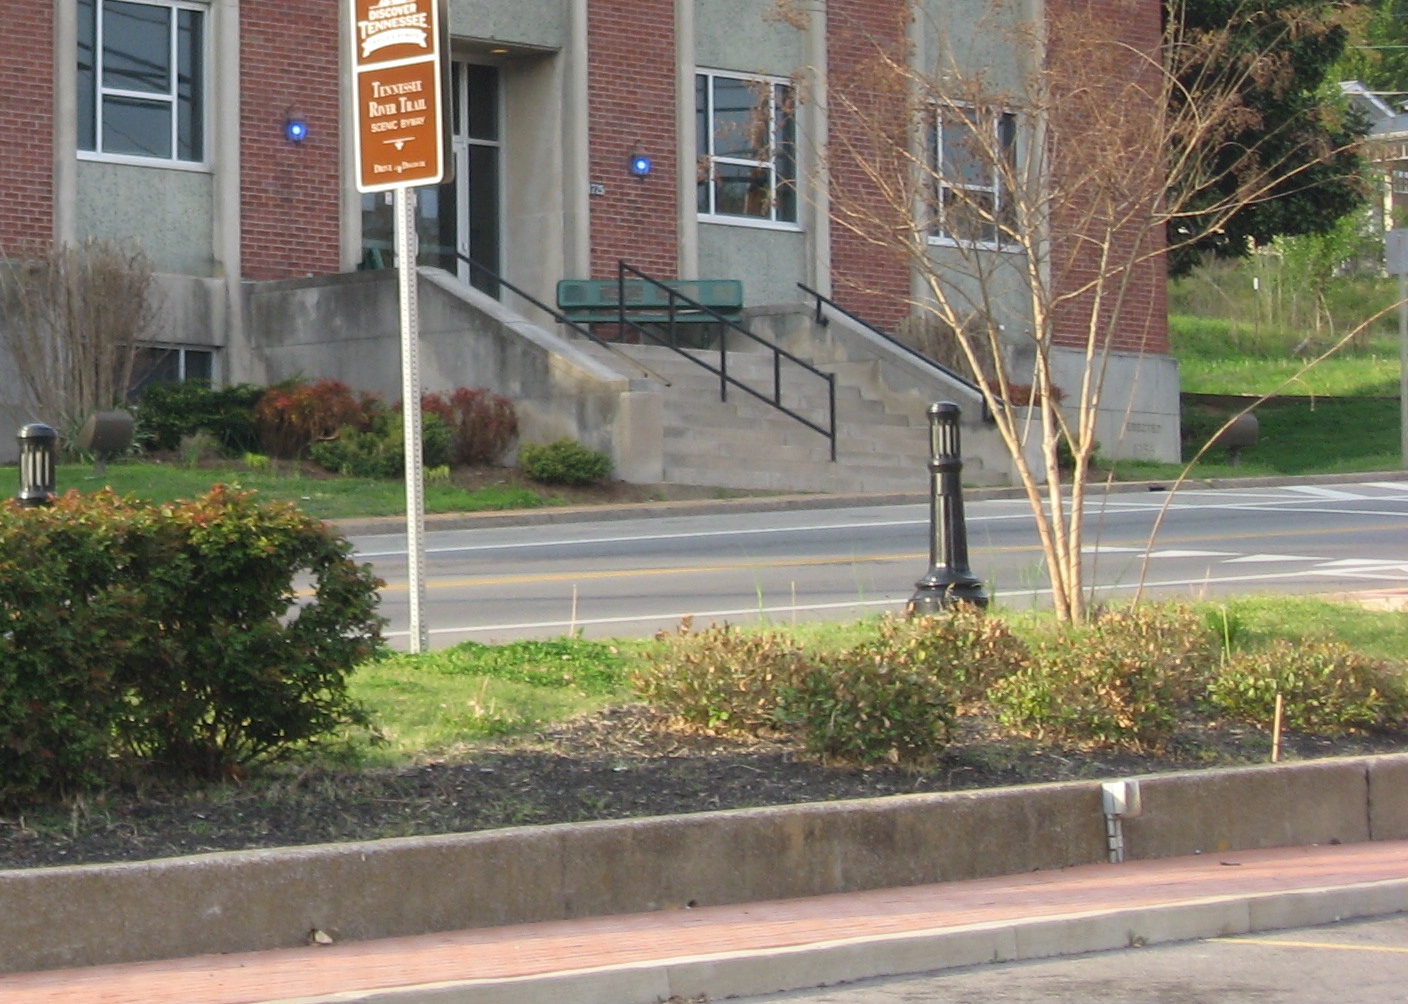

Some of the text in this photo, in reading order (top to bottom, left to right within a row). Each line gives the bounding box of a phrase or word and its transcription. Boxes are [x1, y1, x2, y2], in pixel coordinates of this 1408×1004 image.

[368, 3, 417, 21] DISCOVER
[358, 12, 428, 39] TENNESSEE
[372, 80, 423, 98] TENNESSEE
[369, 96, 427, 118] RIVER TRAIL
[371, 120, 399, 133] SCENIC
